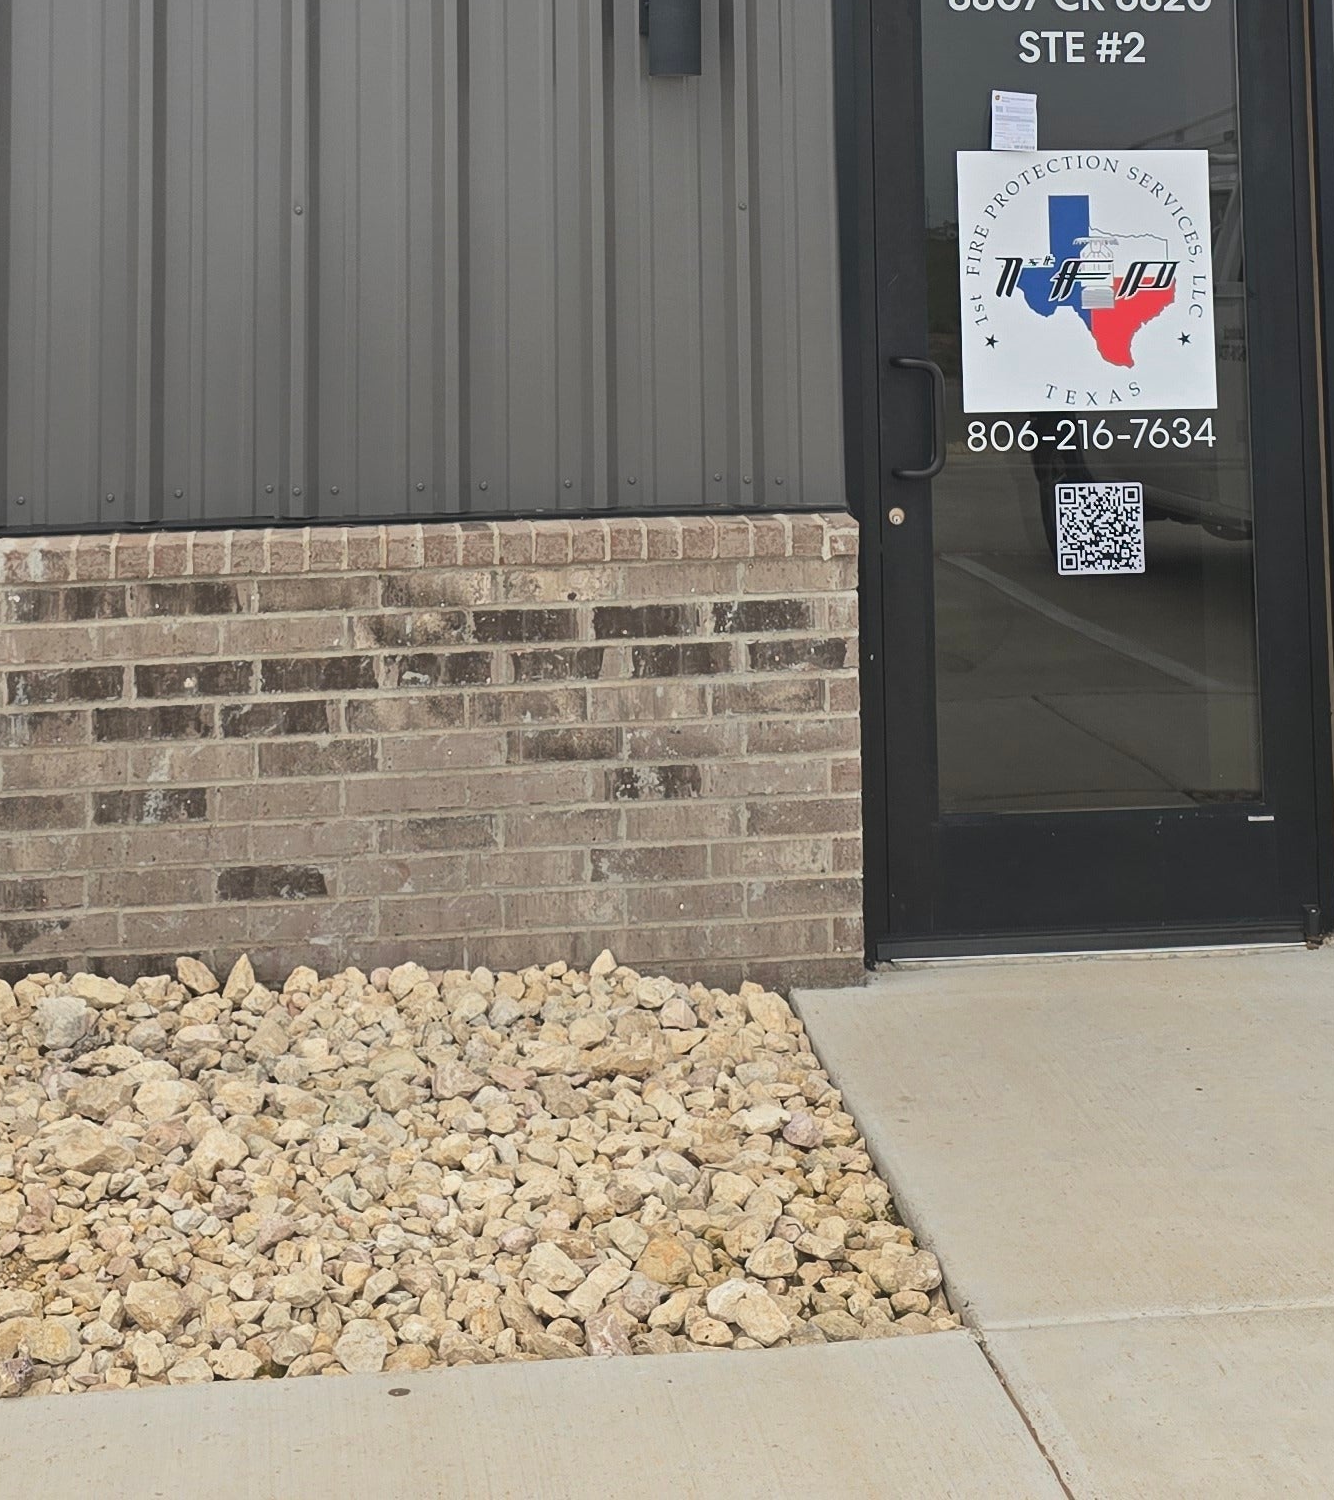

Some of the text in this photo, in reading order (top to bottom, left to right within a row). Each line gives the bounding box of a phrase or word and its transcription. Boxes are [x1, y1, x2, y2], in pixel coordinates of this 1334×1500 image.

[1018, 30, 1146, 64] STE #2
[985, 154, 1120, 222] PROTECTION
[966, 224, 989, 277] FIRE
[970, 293, 989, 326] 1st
[1188, 273, 1207, 320] LLC
[1044, 380, 1142, 408] TEXAS
[966, 417, 1216, 453] 806-216-7634
